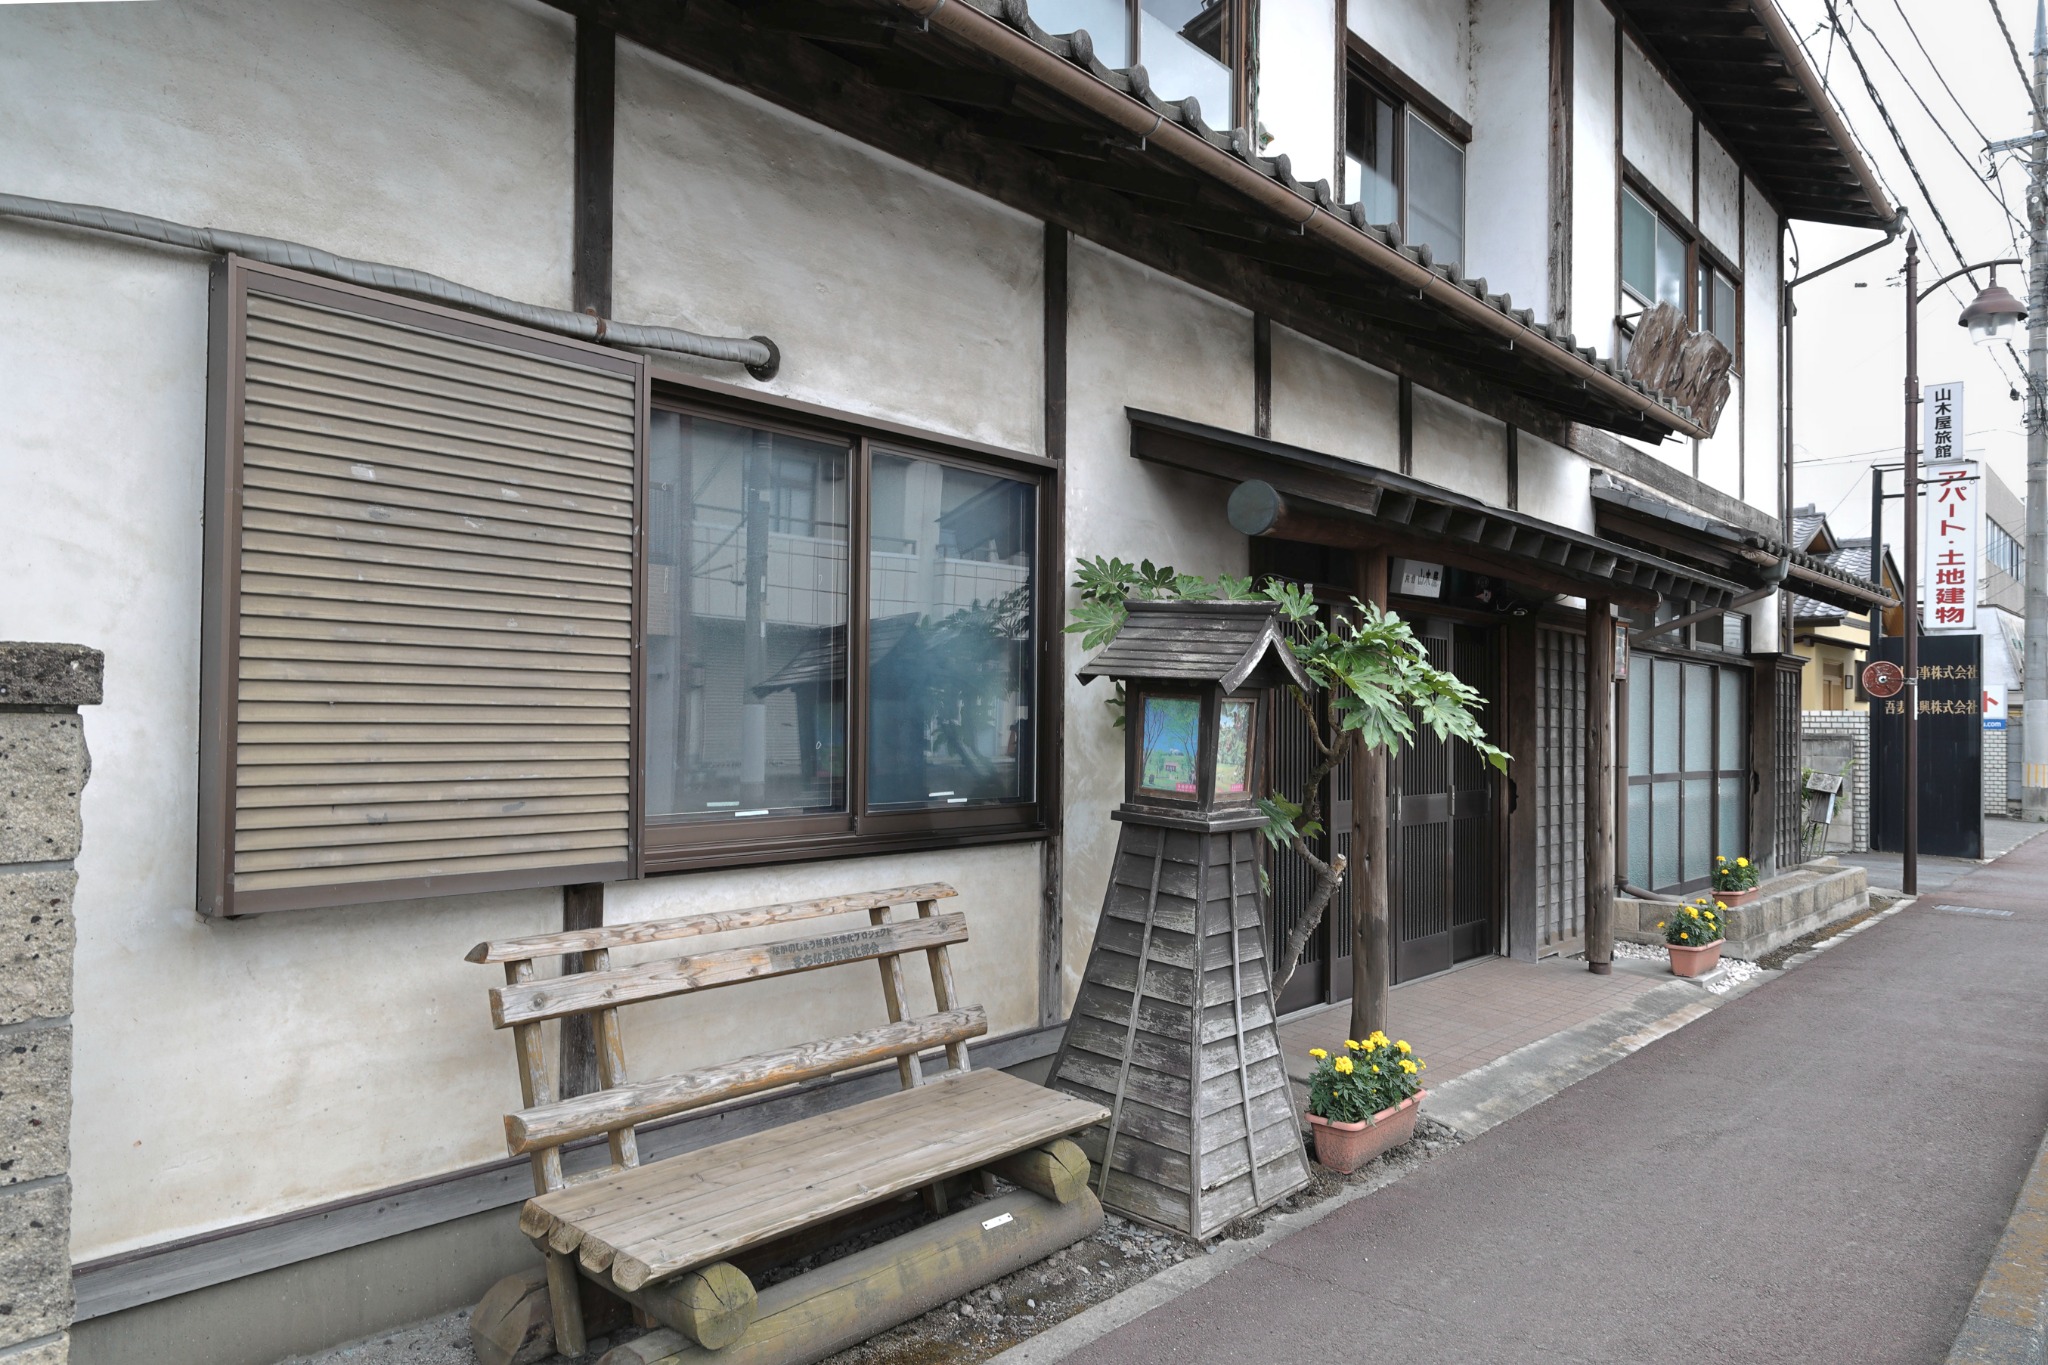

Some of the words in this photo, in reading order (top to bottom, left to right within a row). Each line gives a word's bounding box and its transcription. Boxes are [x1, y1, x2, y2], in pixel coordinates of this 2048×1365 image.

[1934, 388, 1952, 459] 山木屋旅館
[1935, 470, 1967, 623] アパート・土地建物
[1885, 700, 1978, 715] 吾妻興株式会社
